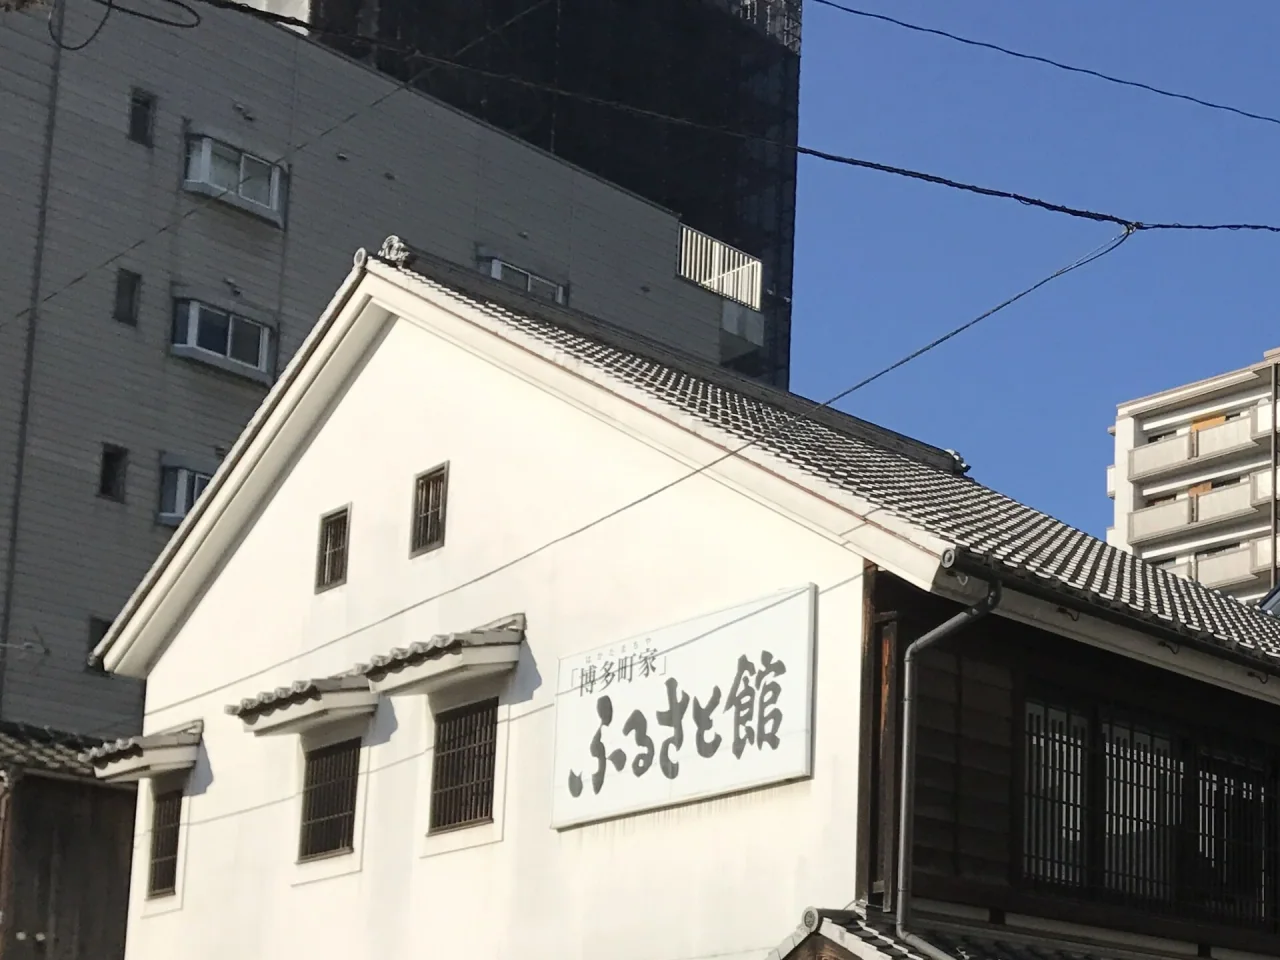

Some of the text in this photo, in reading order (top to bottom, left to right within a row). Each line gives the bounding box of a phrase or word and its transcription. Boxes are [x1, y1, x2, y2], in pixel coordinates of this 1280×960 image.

[568, 650, 787, 798] ふるさと館
